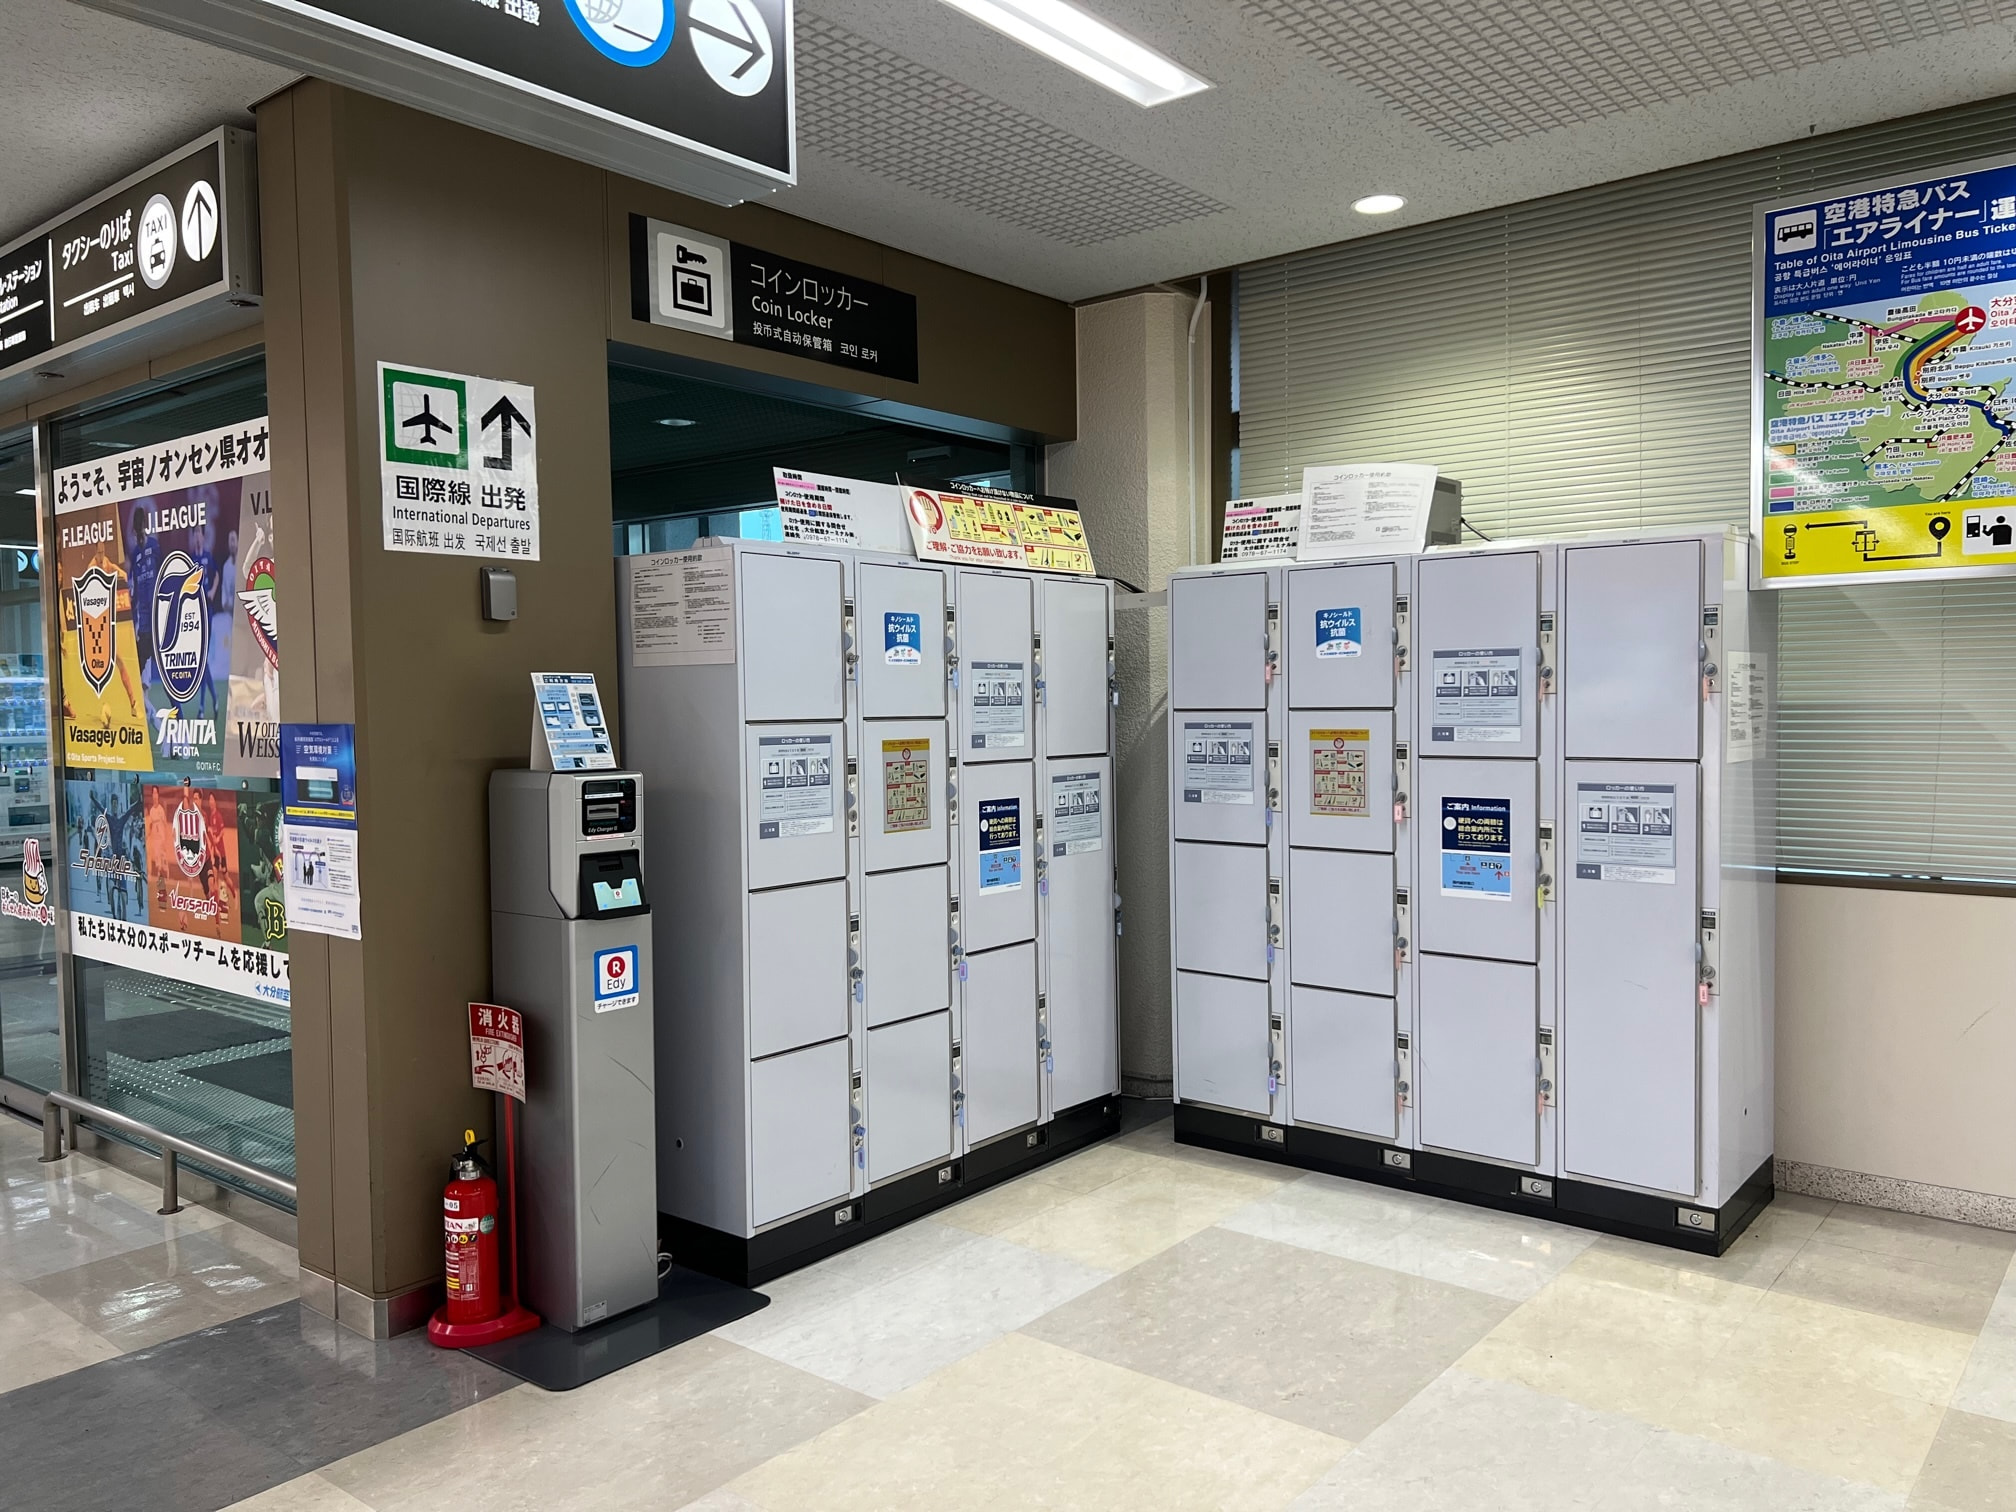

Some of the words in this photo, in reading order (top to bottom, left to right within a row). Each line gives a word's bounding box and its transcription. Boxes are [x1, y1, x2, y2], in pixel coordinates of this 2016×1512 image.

[1823, 180, 1971, 226] 空港特急バス
[145, 213, 168, 233] TAXI
[62, 208, 132, 270] タクシーのりば
[1774, 258, 1804, 271] Table
[1806, 255, 1818, 266] of
[1821, 252, 1844, 263] Oita
[1847, 244, 1887, 259] Airport
[1890, 232, 1953, 251] Limousine
[1955, 228, 1979, 240] Bus
[111, 244, 134, 271] Taxi
[1774, 272, 1791, 282] 공항
[750, 262, 869, 311] コインロッカー
[1773, 291, 1795, 300] Display
[751, 295, 783, 318] Coin
[787, 308, 833, 330] Locker
[1990, 310, 2010, 318] Oita
[753, 320, 833, 353] 投币式自动保管箱
[840, 342, 858, 358] 코인
[861, 347, 878, 363] 로커
[1902, 407, 1969, 419] パークプレイス大分
[1786, 425, 1810, 435] Airport
[1812, 421, 1849, 431] Limousine
[396, 475, 472, 506] 国際線
[481, 484, 526, 512] 出発
[144, 502, 207, 535] J.LEAGUE
[393, 506, 468, 525] International
[472, 513, 531, 531] Departures
[62, 519, 114, 549] F.LEAGUE
[392, 528, 440, 549] 国际航班
[443, 531, 466, 551] 出发
[474, 534, 507, 553] 국제선
[510, 536, 532, 555] 출발
[83, 596, 107, 608] Vasagey
[184, 612, 196, 621] EST
[1320, 618, 1356, 629] 抗ウイルス
[180, 621, 200, 632] 1994
[888, 623, 917, 633] 抗ウイルス
[1330, 627, 1347, 637] 抗菌
[896, 633, 909, 643] 抗菌
[91, 658, 104, 670] Oita
[164, 651, 197, 668] TRINITA
[156, 706, 217, 745] TRINITA
[70, 726, 116, 748] Vasagey
[119, 727, 143, 745] Oita
[173, 746, 183, 756] FC
[184, 746, 200, 757] OITA
[81, 754, 97, 763] Sports
[98, 755, 116, 764] Project
[1446, 802, 1469, 811] ご案内
[597, 826, 613, 834] Charger
[1457, 833, 1507, 842] 行っております。
[607, 978, 626, 990] Edy
[597, 996, 636, 1010] チャージできます
[478, 1007, 520, 1036] 消火器
